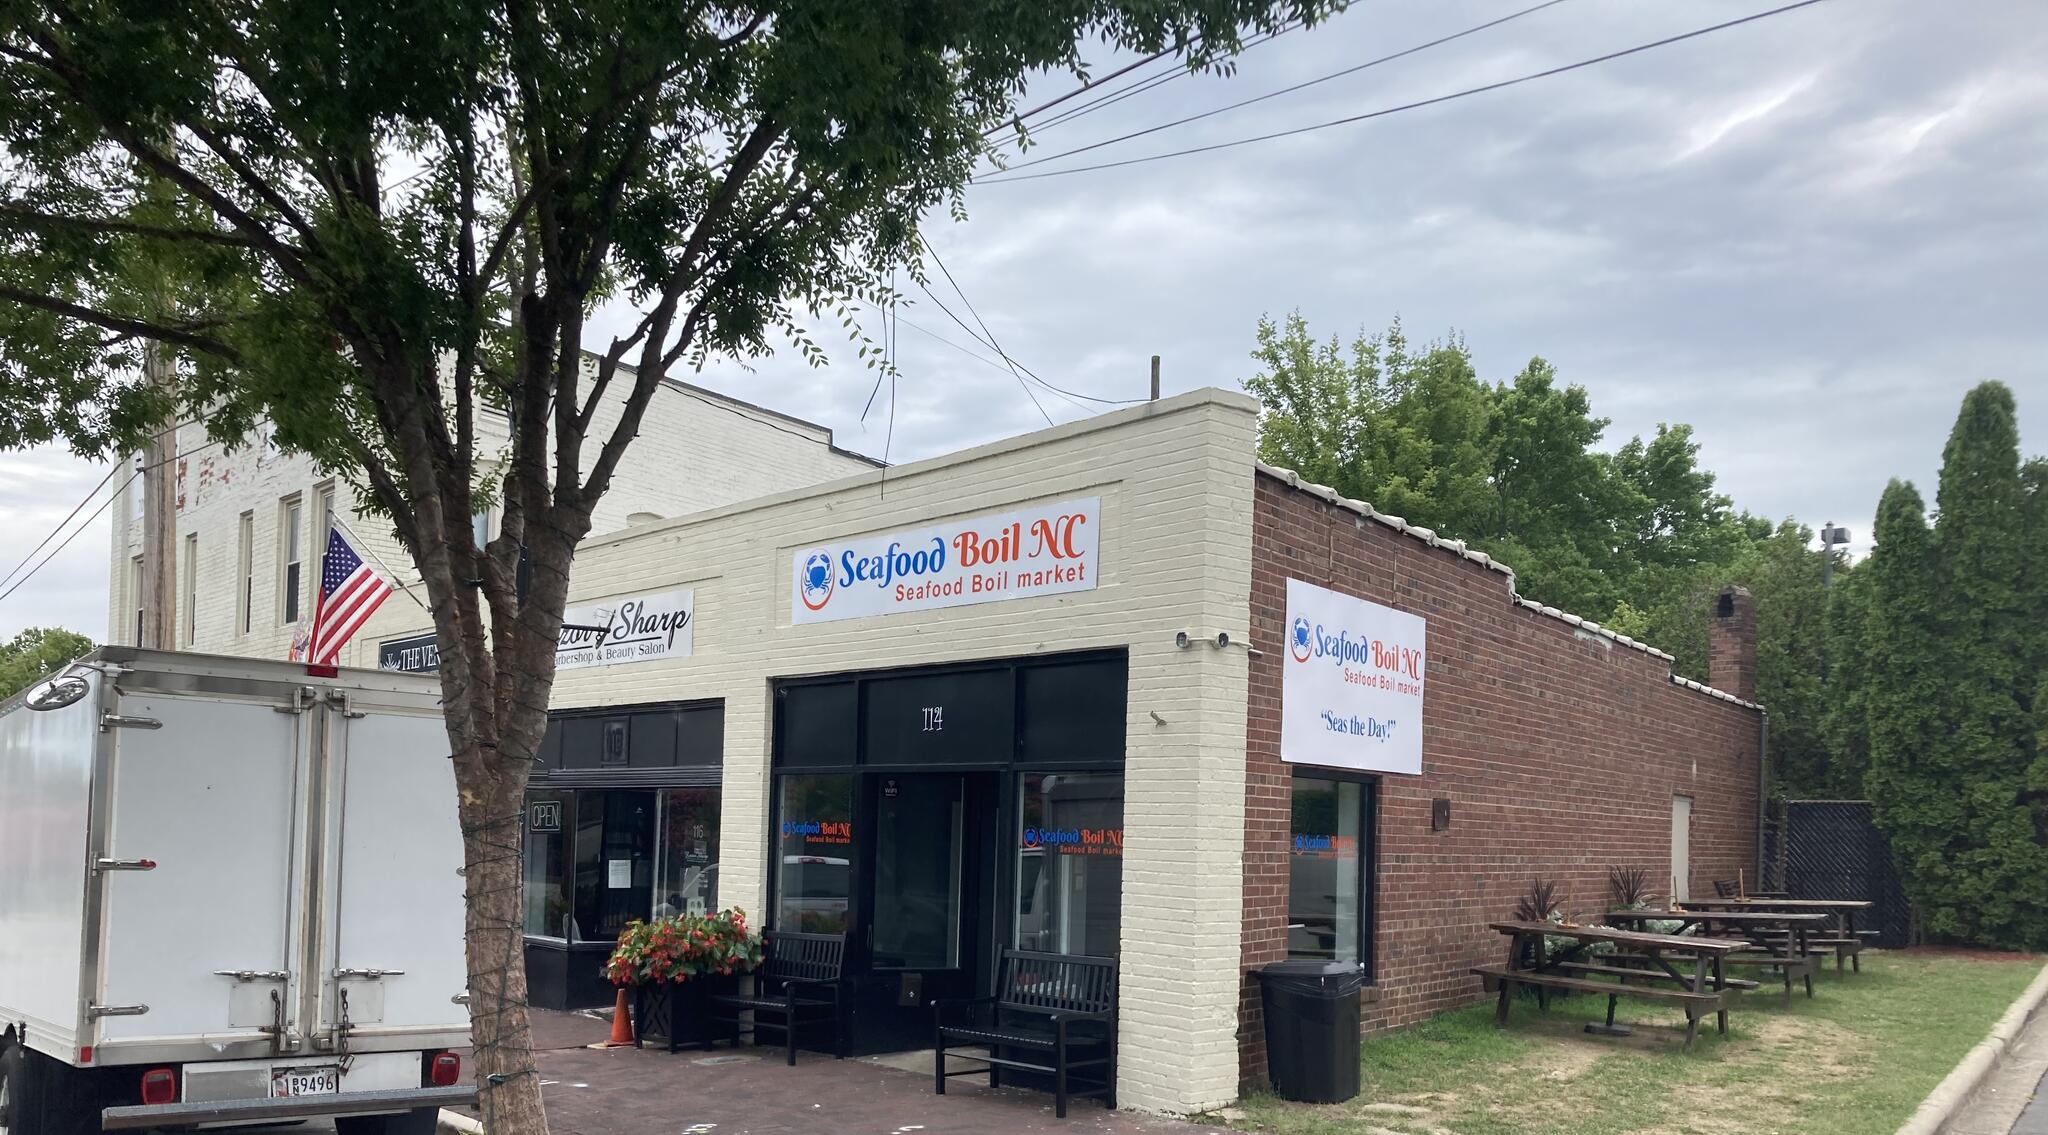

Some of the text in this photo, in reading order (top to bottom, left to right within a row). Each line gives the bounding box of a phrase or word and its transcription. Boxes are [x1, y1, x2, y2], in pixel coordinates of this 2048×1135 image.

[840, 514, 1086, 588] Seafood Boil NC
[895, 562, 1085, 602] Seafood Boil market
[613, 600, 692, 650] Sharp
[401, 644, 440, 671] THE VEN
[606, 645, 636, 662] Beauty
[638, 642, 665, 655] Salon
[1315, 624, 1421, 681] Seafood Boil NC
[1344, 667, 1420, 697] Seafood Boil market
[922, 706, 943, 731] 114
[1350, 715, 1365, 736] the
[534, 805, 559, 826] OPEN
[792, 821, 820, 836] Seafood
[821, 822, 837, 835] Boil
[1039, 828, 1079, 846] Seafood
[1081, 828, 1104, 844] Boil
